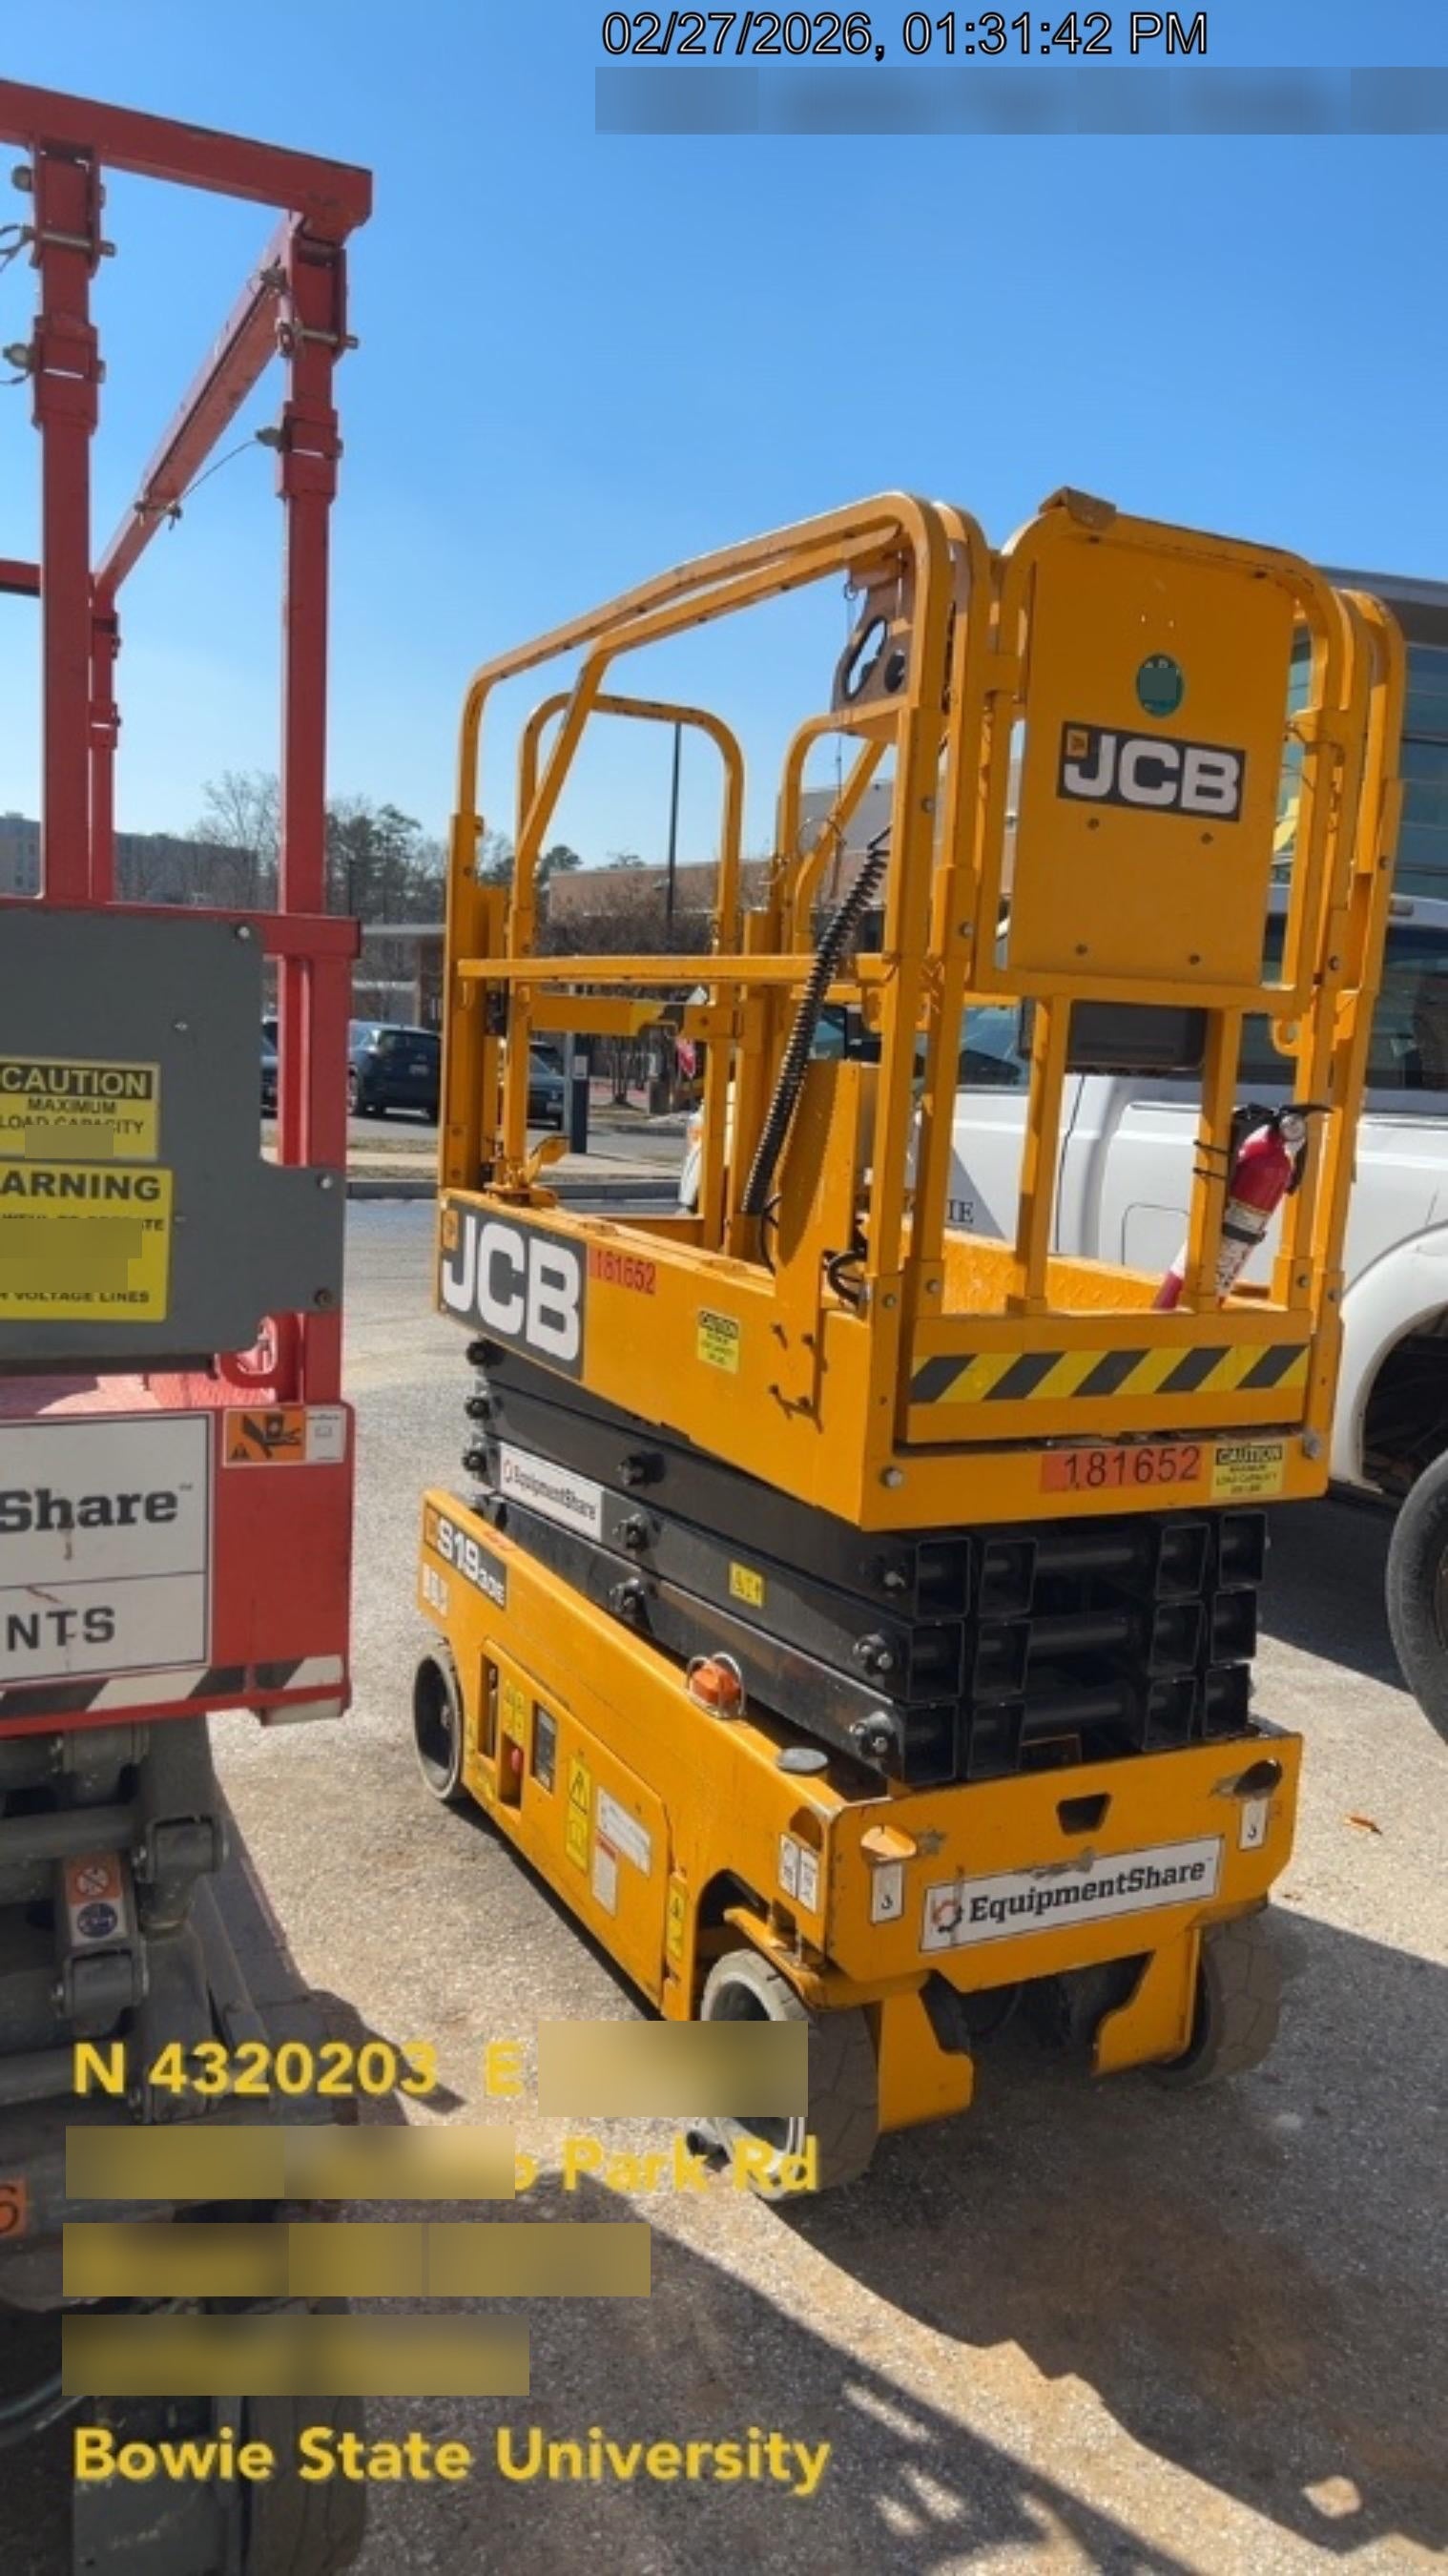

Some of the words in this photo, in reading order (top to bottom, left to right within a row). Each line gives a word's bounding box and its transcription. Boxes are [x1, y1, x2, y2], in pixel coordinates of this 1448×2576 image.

[1064, 734, 1240, 814] JCB
[2, 1067, 147, 1096] CAUTION
[28, 1097, 116, 1114] MAXIMUM
[443, 1215, 580, 1361] JCB
[596, 1249, 656, 1295] 181652
[99, 1289, 150, 1304] LINES
[1064, 1444, 1201, 1489] 181652
[969, 1860, 1207, 1924] EquipmentShare
